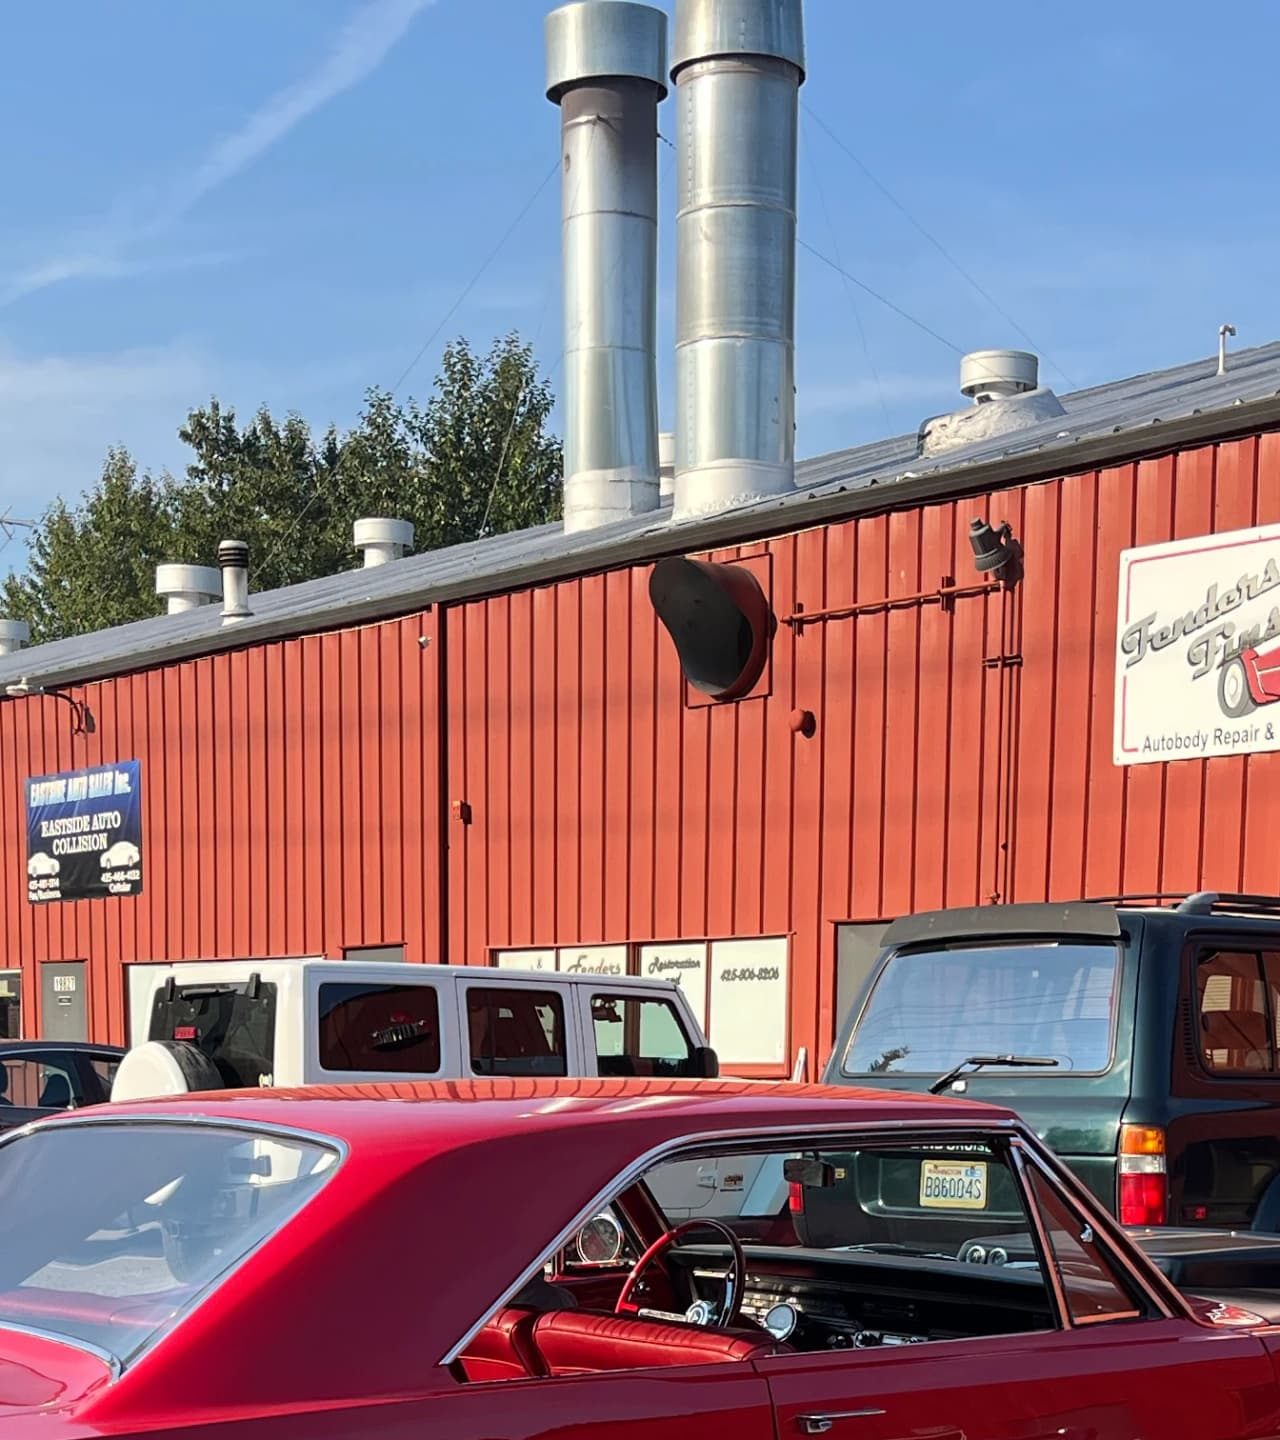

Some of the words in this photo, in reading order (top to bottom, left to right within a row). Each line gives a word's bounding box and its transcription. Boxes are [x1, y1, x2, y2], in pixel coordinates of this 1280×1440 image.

[1142, 730, 1209, 753] Autobody
[1214, 724, 1260, 747] Repair
[1265, 723, 1275, 740] &
[40, 815, 90, 838] EASTSIDE
[91, 811, 121, 831] AUTO
[52, 833, 108, 855] COLLISION
[648, 956, 701, 975] Restoration
